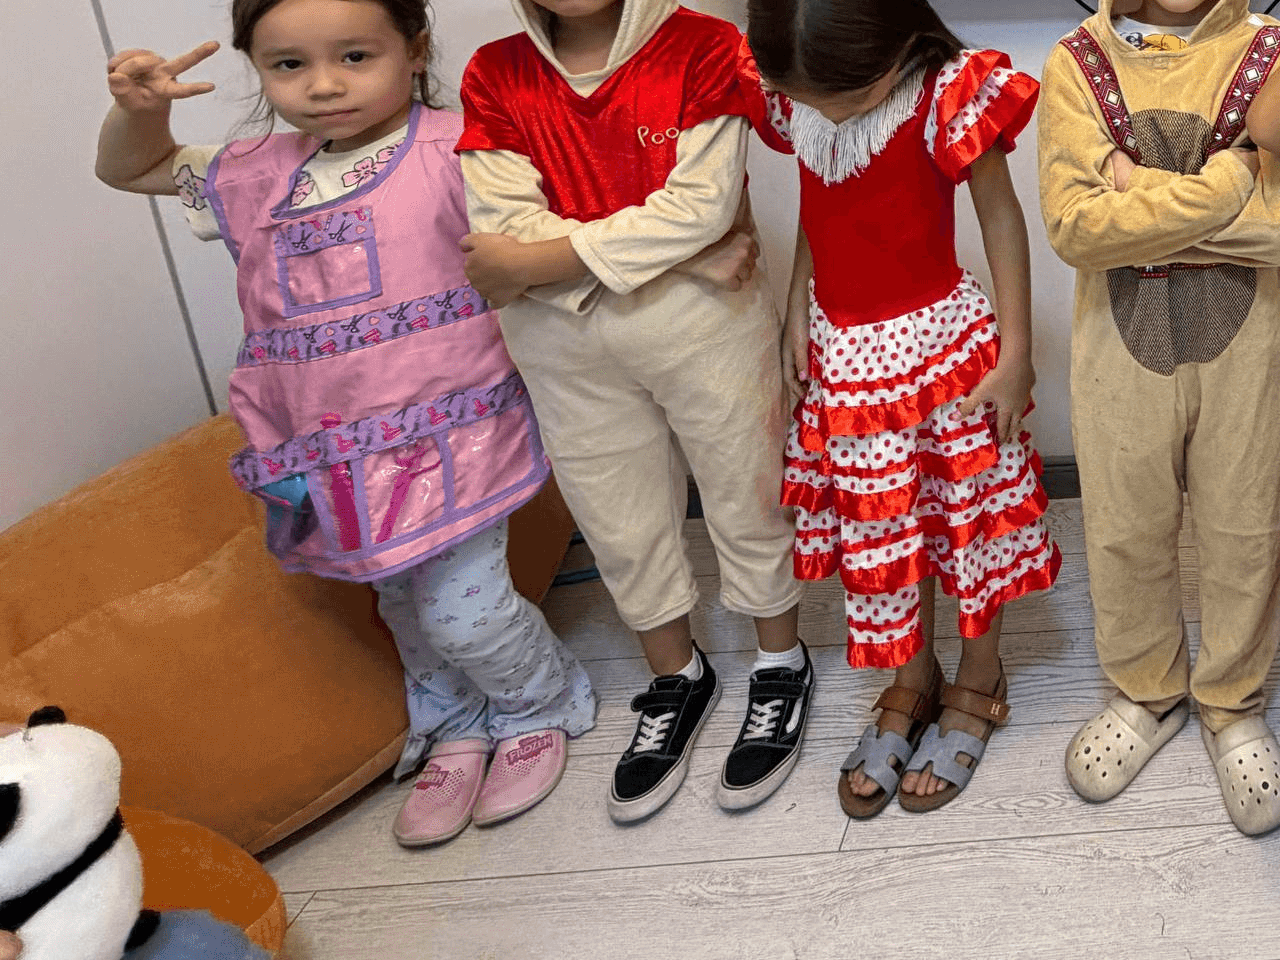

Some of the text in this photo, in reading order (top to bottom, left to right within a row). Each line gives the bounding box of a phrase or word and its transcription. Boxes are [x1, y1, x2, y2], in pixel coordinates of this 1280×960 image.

[636, 126, 680, 148] Poo
[990, 703, 1001, 716] H
[509, 734, 552, 761] FROZEN
